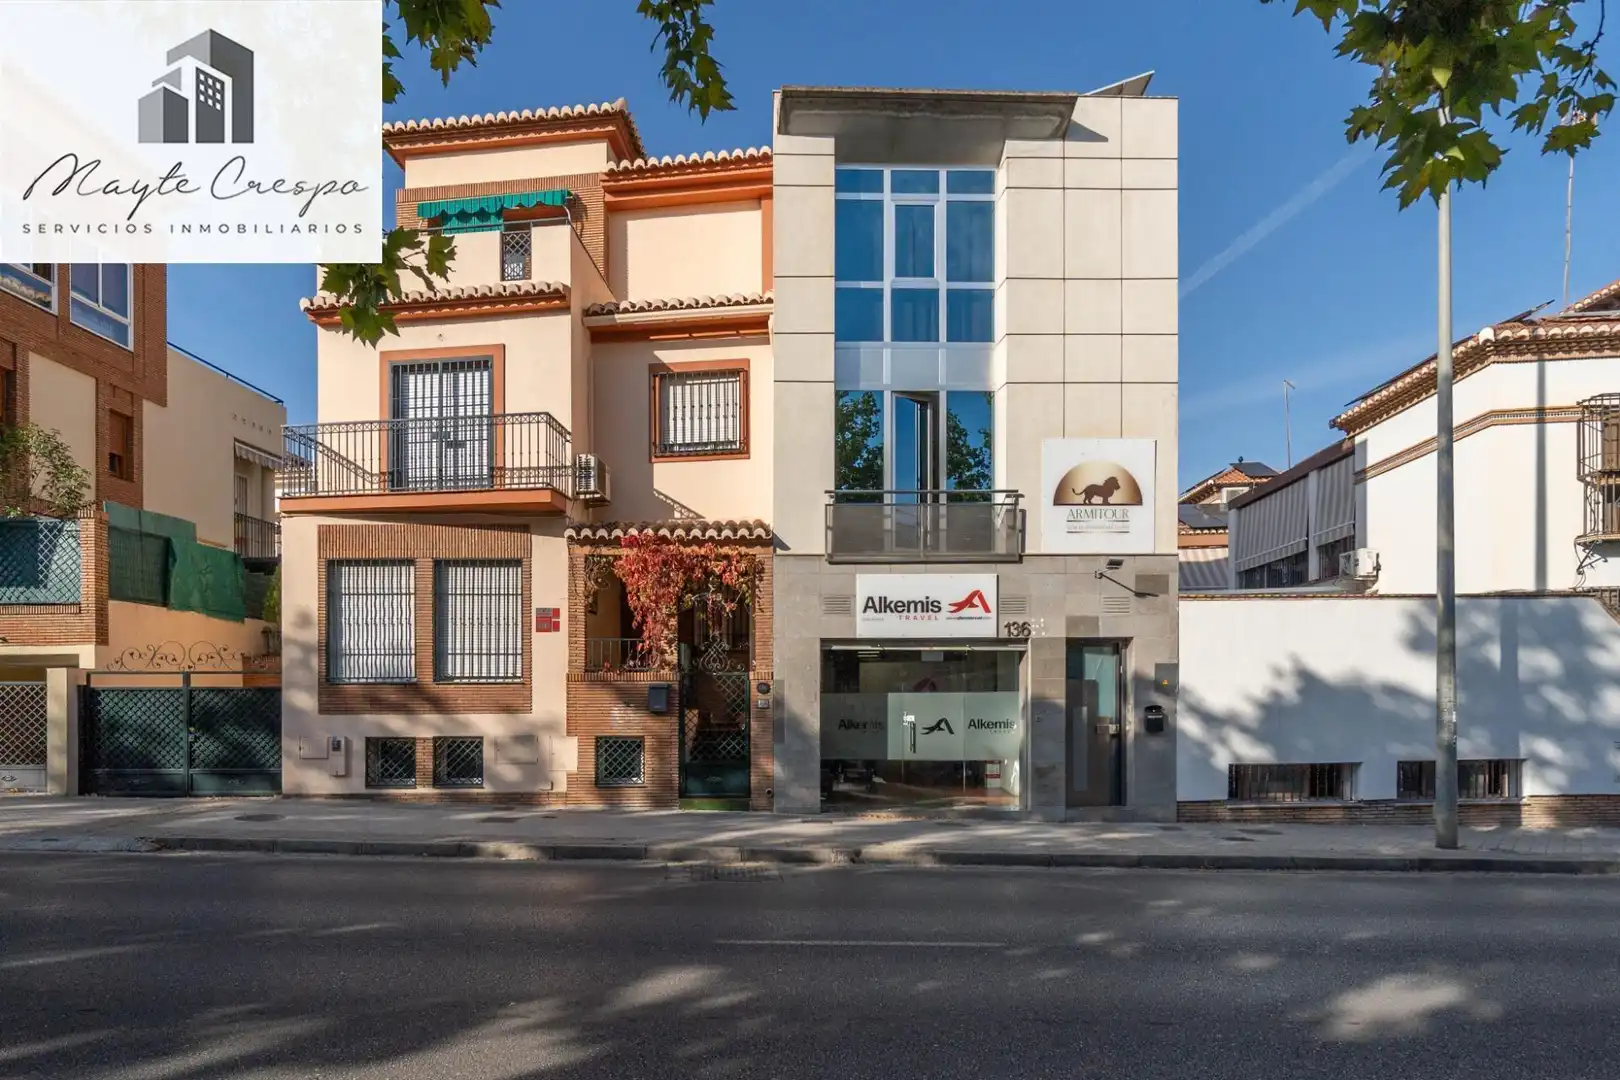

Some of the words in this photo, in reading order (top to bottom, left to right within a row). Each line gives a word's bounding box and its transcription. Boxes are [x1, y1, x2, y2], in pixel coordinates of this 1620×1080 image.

[1066, 508, 1129, 519] ARMITOUR
[862, 596, 942, 614] Alkemis
[1004, 621, 1032, 637] 136
[968, 718, 1016, 730] Alkemis
